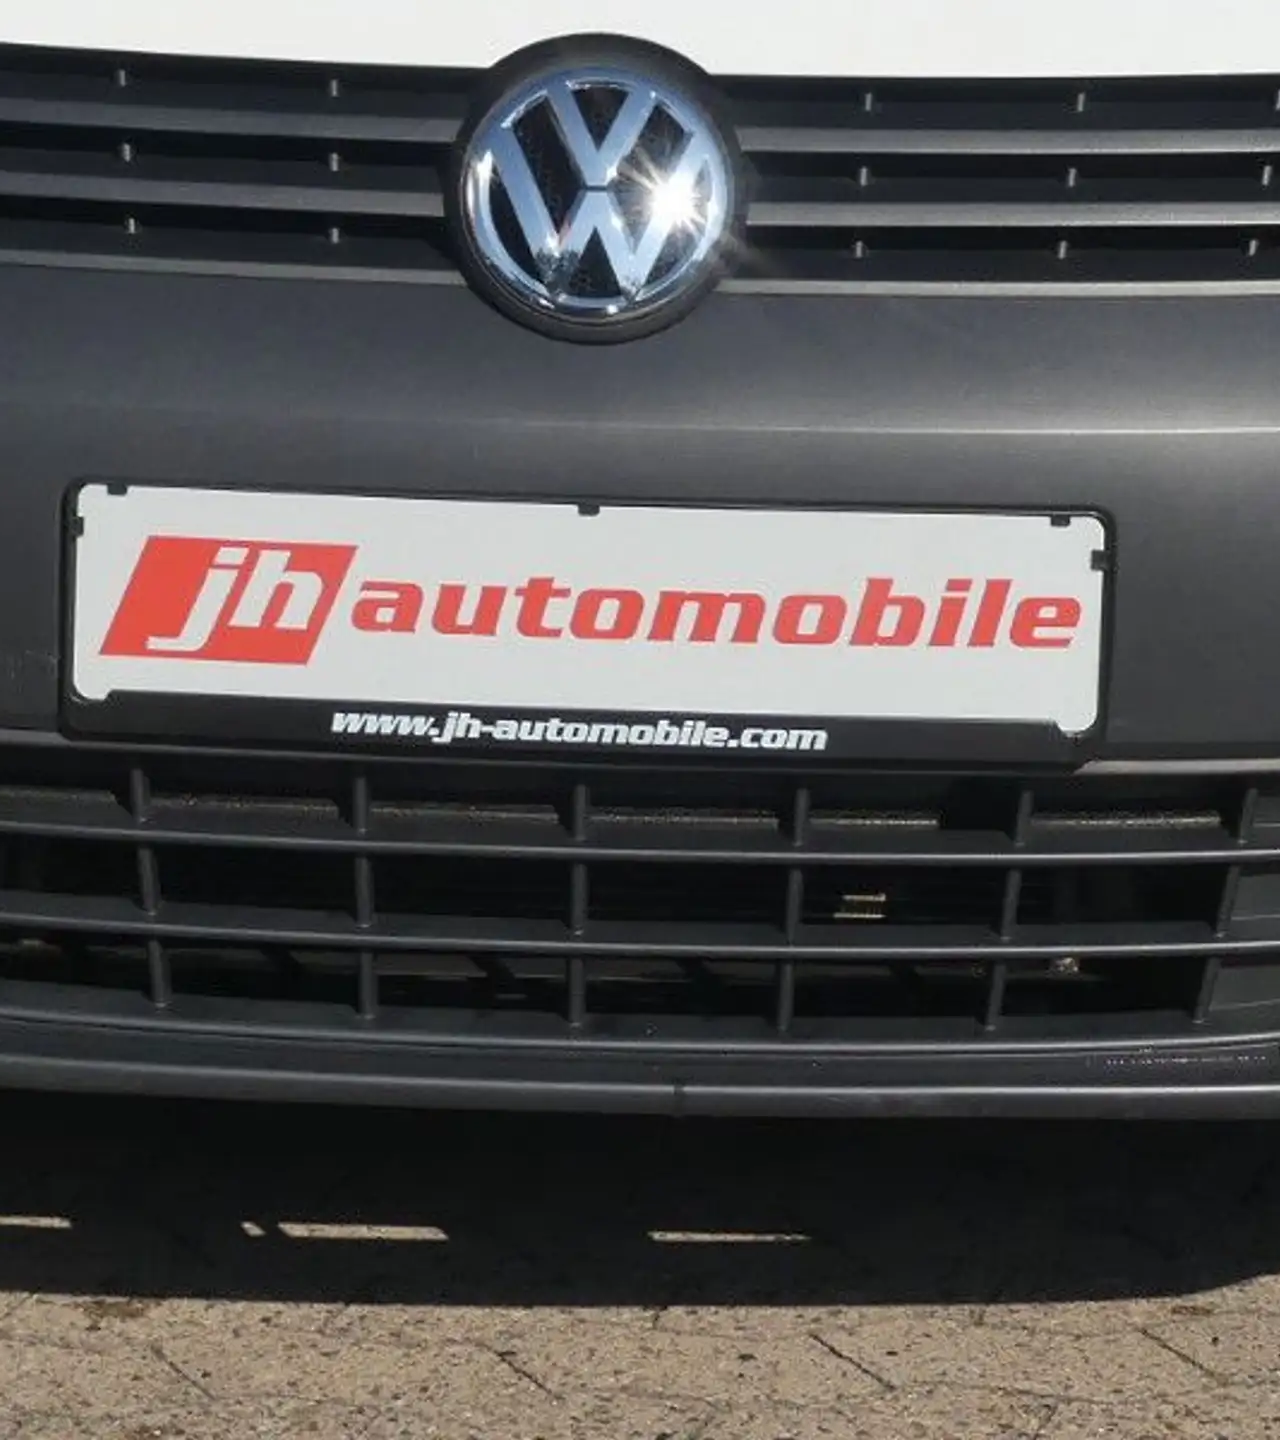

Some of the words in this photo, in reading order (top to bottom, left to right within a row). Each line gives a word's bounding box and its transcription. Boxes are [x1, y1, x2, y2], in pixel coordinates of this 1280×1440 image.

[145, 546, 325, 652] jh
[351, 576, 1082, 647] automobile
[330, 711, 829, 751] www.jh-automobile.com
